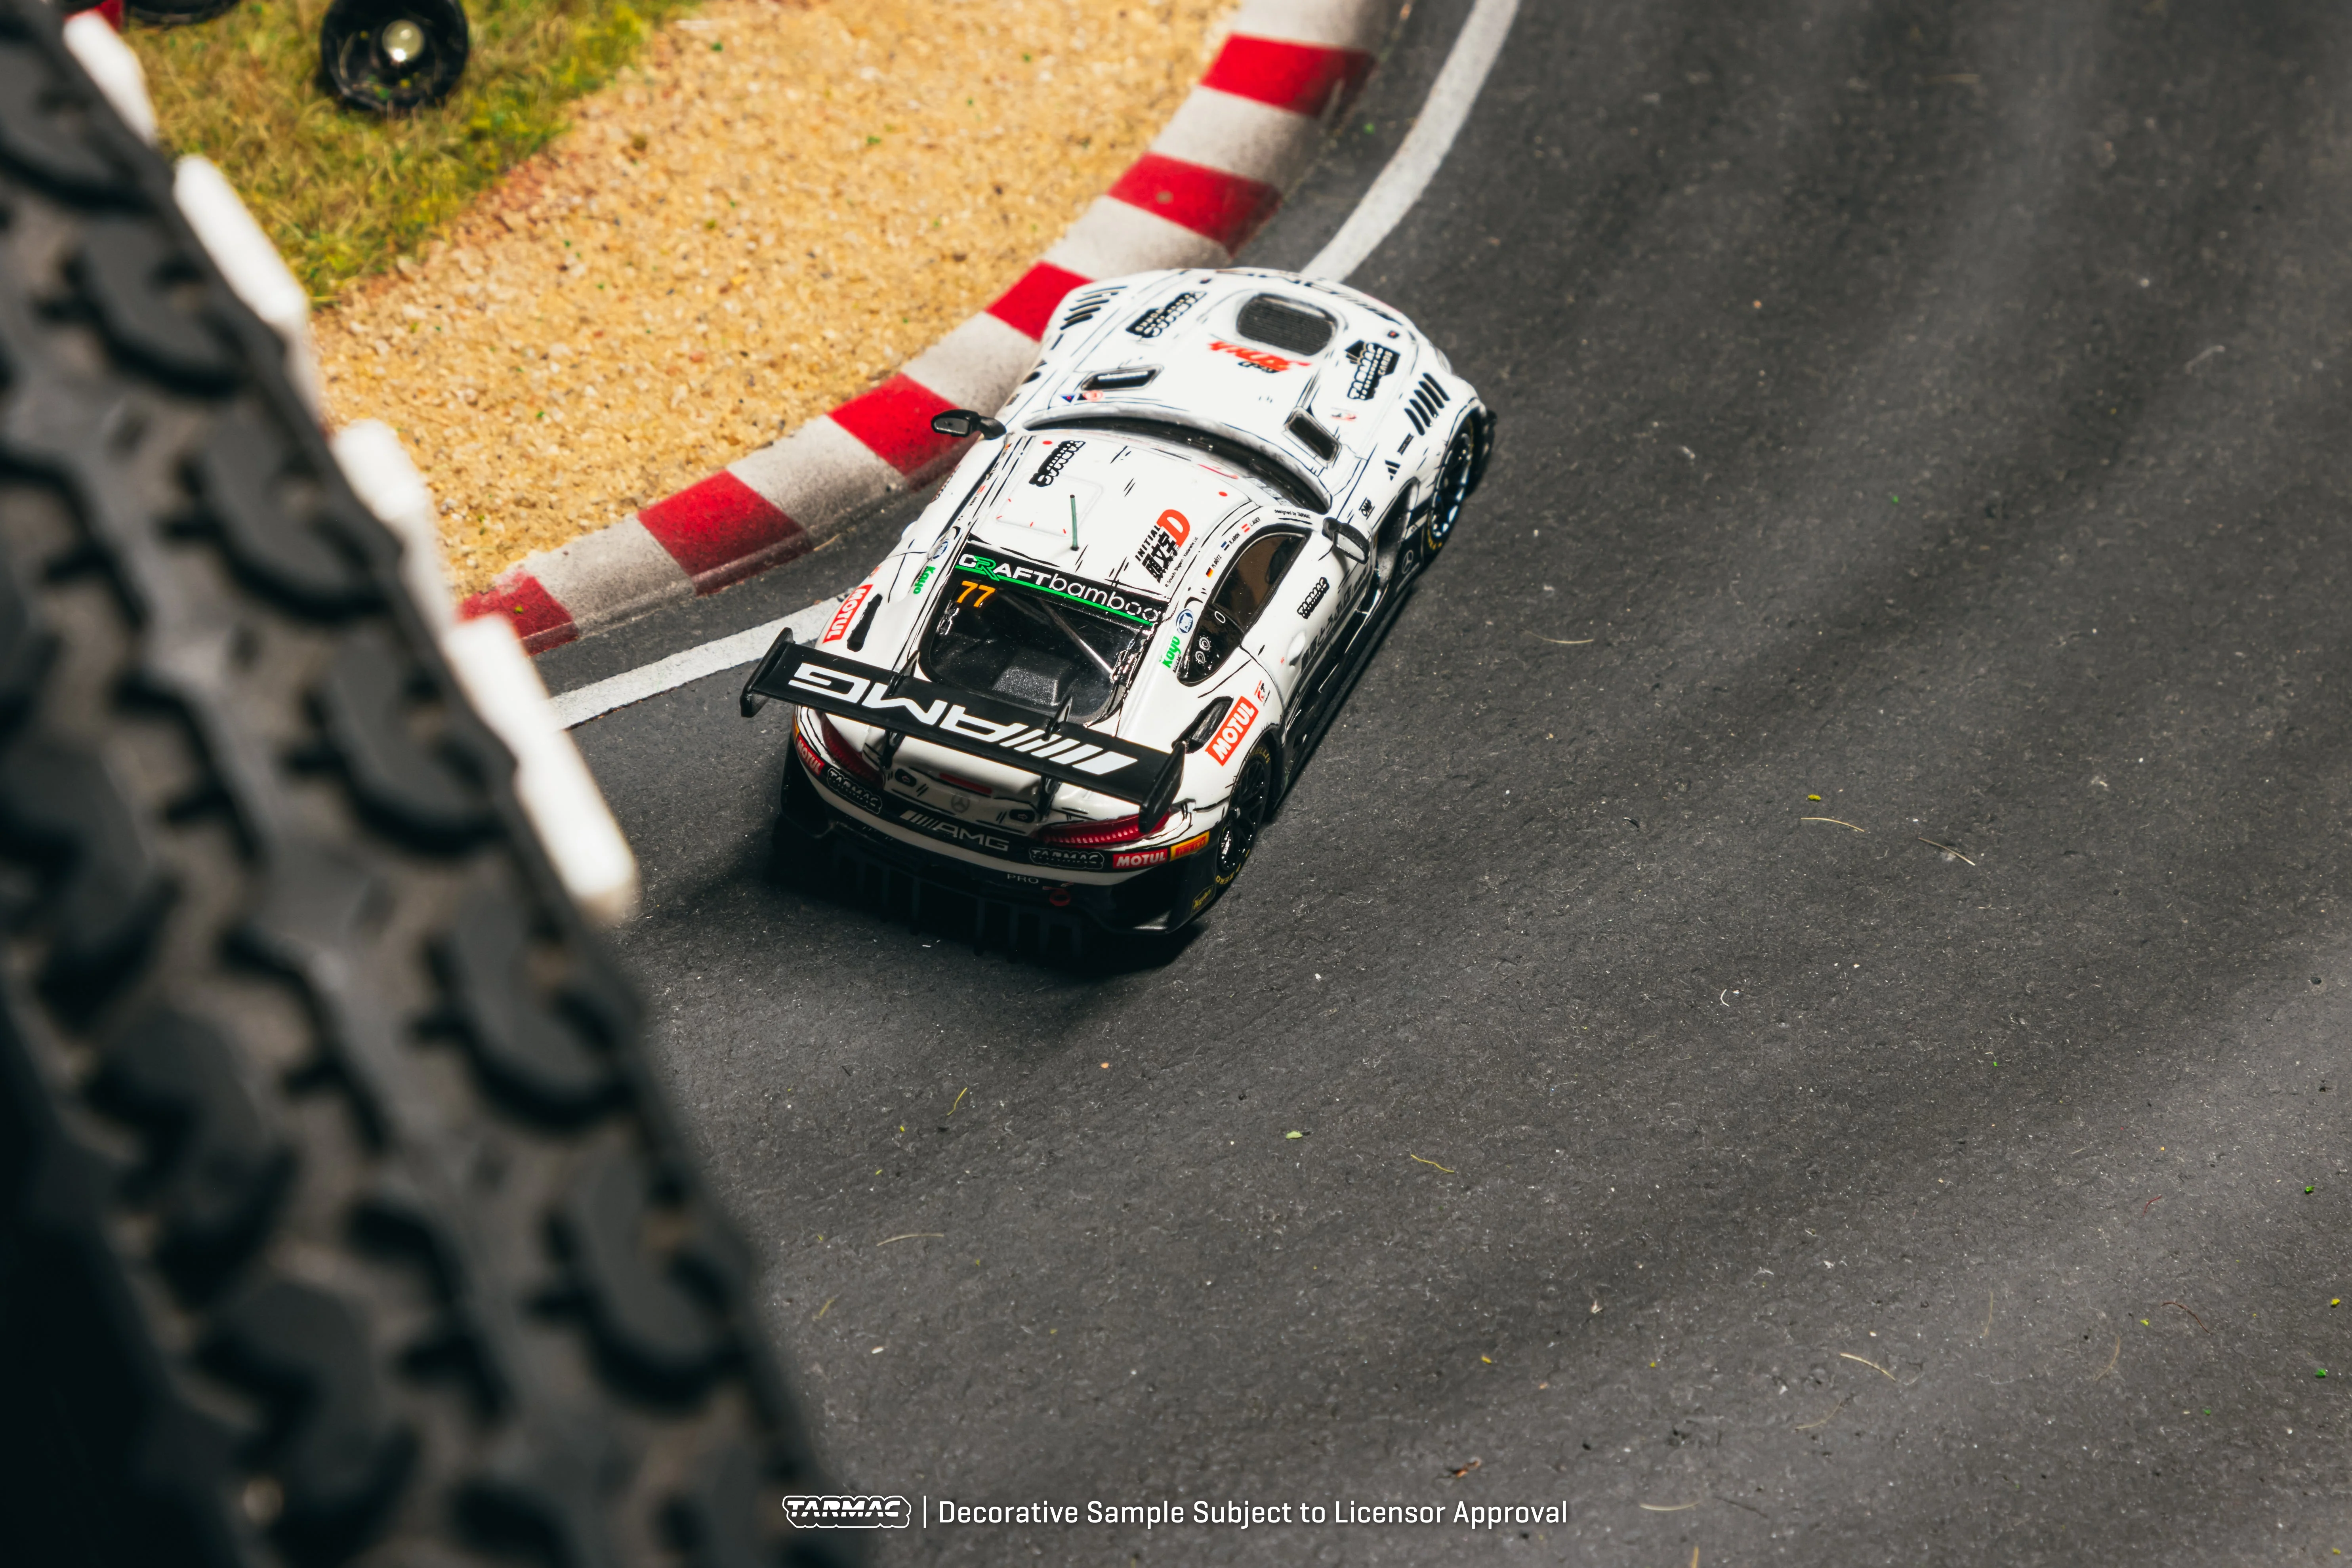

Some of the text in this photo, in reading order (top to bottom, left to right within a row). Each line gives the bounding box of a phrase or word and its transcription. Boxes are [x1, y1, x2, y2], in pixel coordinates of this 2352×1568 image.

[1349, 343, 1383, 400] TARMAC
[1378, 351, 1393, 376] CARDS
[1037, 440, 1084, 485] TARMAC
[1361, 500, 1372, 517] OMP
[1135, 510, 1190, 561] INITIAL D
[913, 566, 936, 594] Kayo
[957, 581, 995, 607] 77
[826, 587, 866, 639] MOTUL
[1298, 578, 1328, 617] TARMAC
[1160, 636, 1181, 668] Kayo
[1212, 702, 1255, 761] MOTUL
[797, 739, 822, 774] MOTUL
[830, 770, 879, 808] TARMAC
[1032, 850, 1099, 865] TARMAC
[1116, 851, 1166, 867] MOTUL
[1175, 836, 1206, 857] PIRELLI
[1007, 874, 1039, 884] PRO
